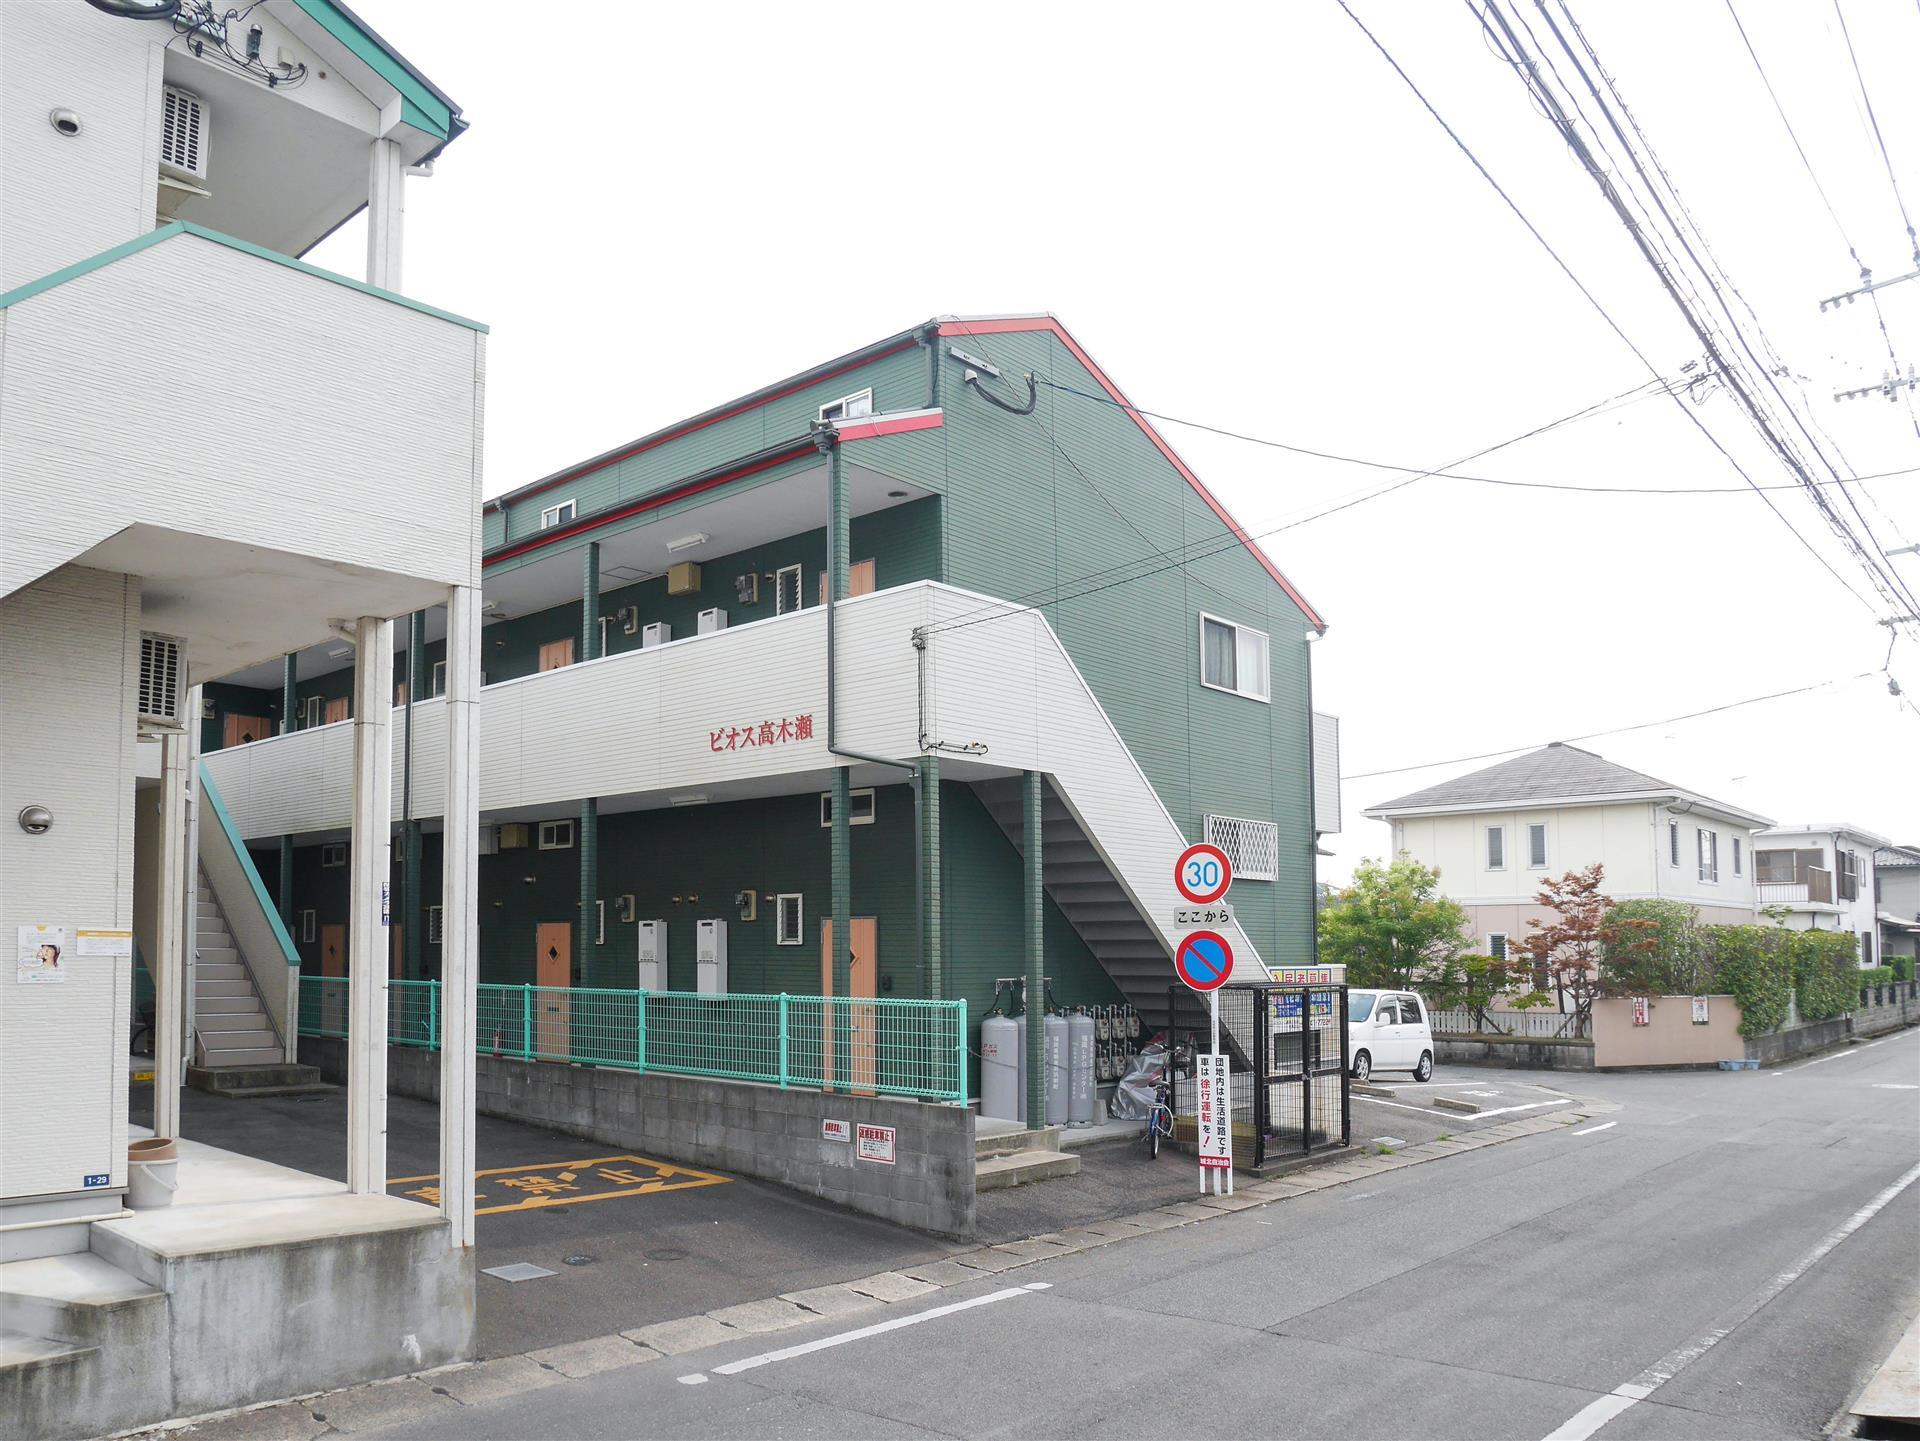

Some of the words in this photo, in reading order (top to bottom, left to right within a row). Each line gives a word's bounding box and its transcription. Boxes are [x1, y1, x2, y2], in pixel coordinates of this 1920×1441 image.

[709, 714, 814, 752] ビオス高木瀬
[1187, 861, 1219, 887] 30
[1178, 909, 1229, 923] ここから
[1215, 1057, 1226, 1155] 団地内は生活道路です
[87, 1176, 107, 1185] 1-29
